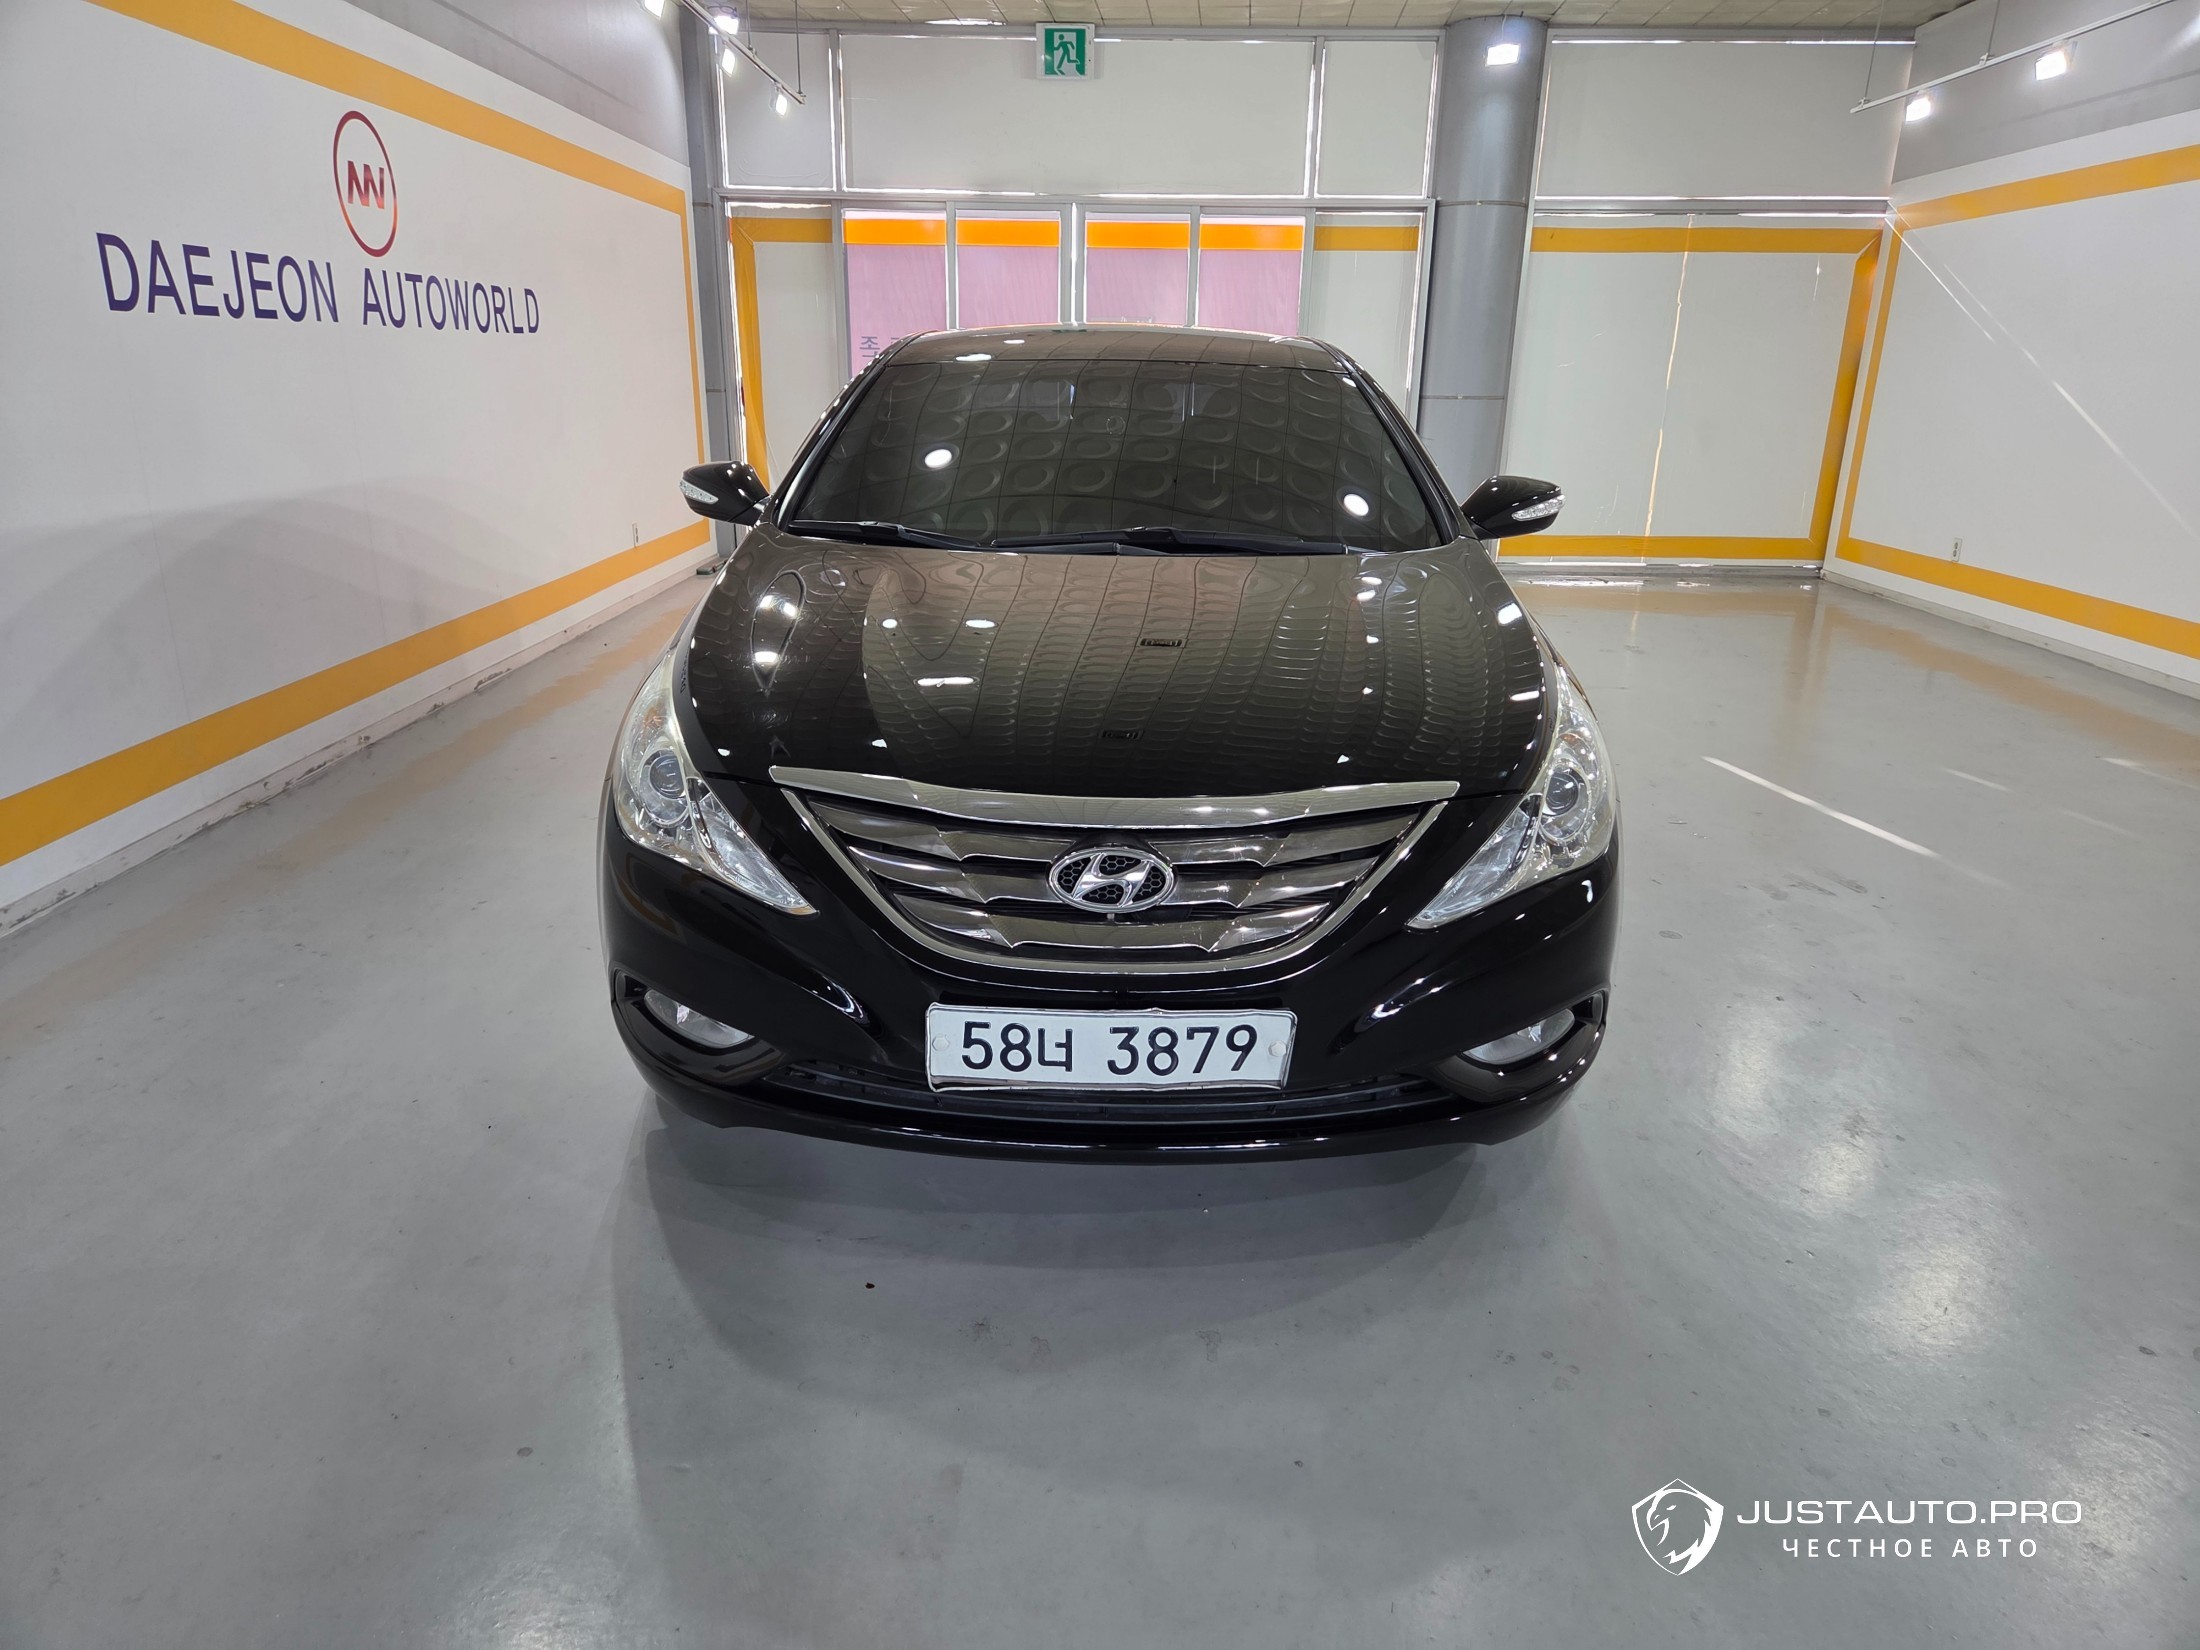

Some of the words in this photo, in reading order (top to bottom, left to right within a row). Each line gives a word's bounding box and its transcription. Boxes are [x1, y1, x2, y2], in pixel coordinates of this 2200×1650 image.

[96, 232, 339, 323] DAEJEON
[363, 267, 540, 334] AUTOWORLD
[961, 1020, 1074, 1073] 58너
[1107, 1024, 1258, 1077] 3879
